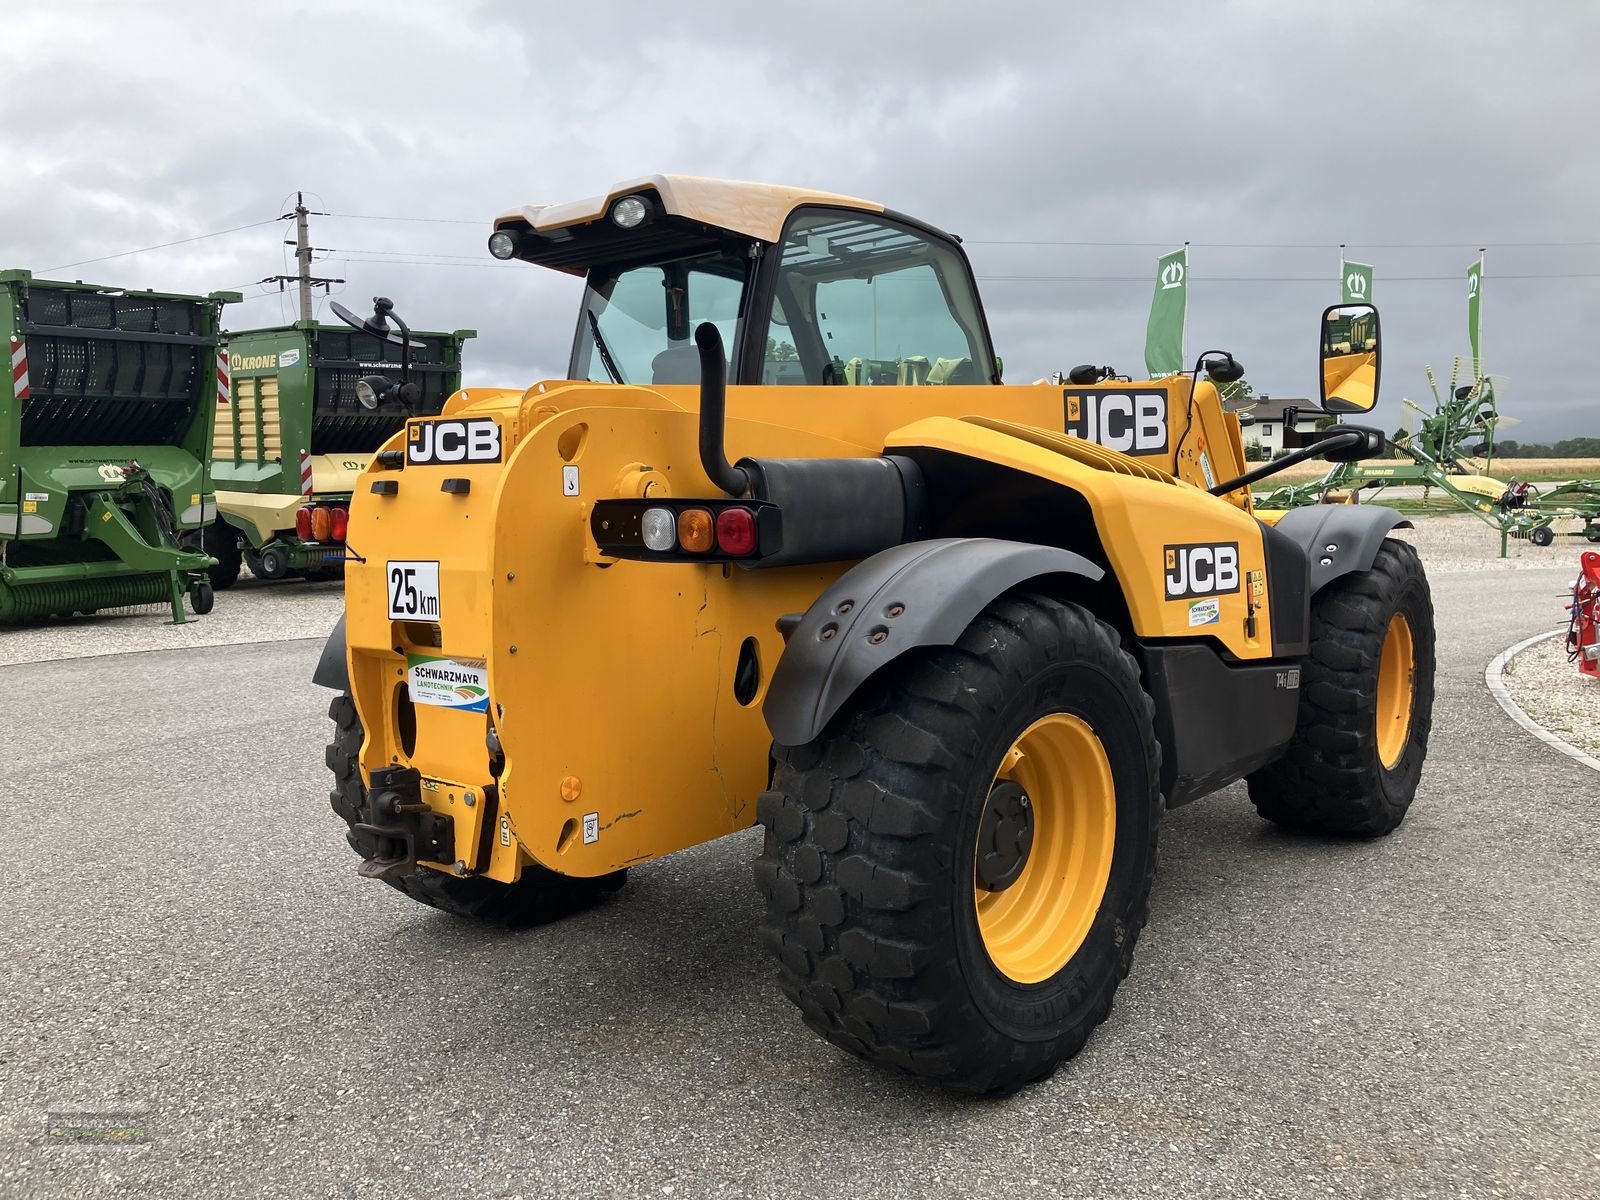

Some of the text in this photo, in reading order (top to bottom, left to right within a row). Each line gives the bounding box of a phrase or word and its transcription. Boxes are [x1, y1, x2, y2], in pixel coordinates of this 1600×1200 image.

[242, 354, 277, 370] KRONE
[409, 421, 500, 462] JCB
[1067, 394, 1167, 452] JCB
[1166, 546, 1239, 595] JCB
[391, 567, 438, 616] 25 km
[415, 666, 479, 685] SCHWARZMAYR
[416, 680, 454, 692] LANDTECHNIK
